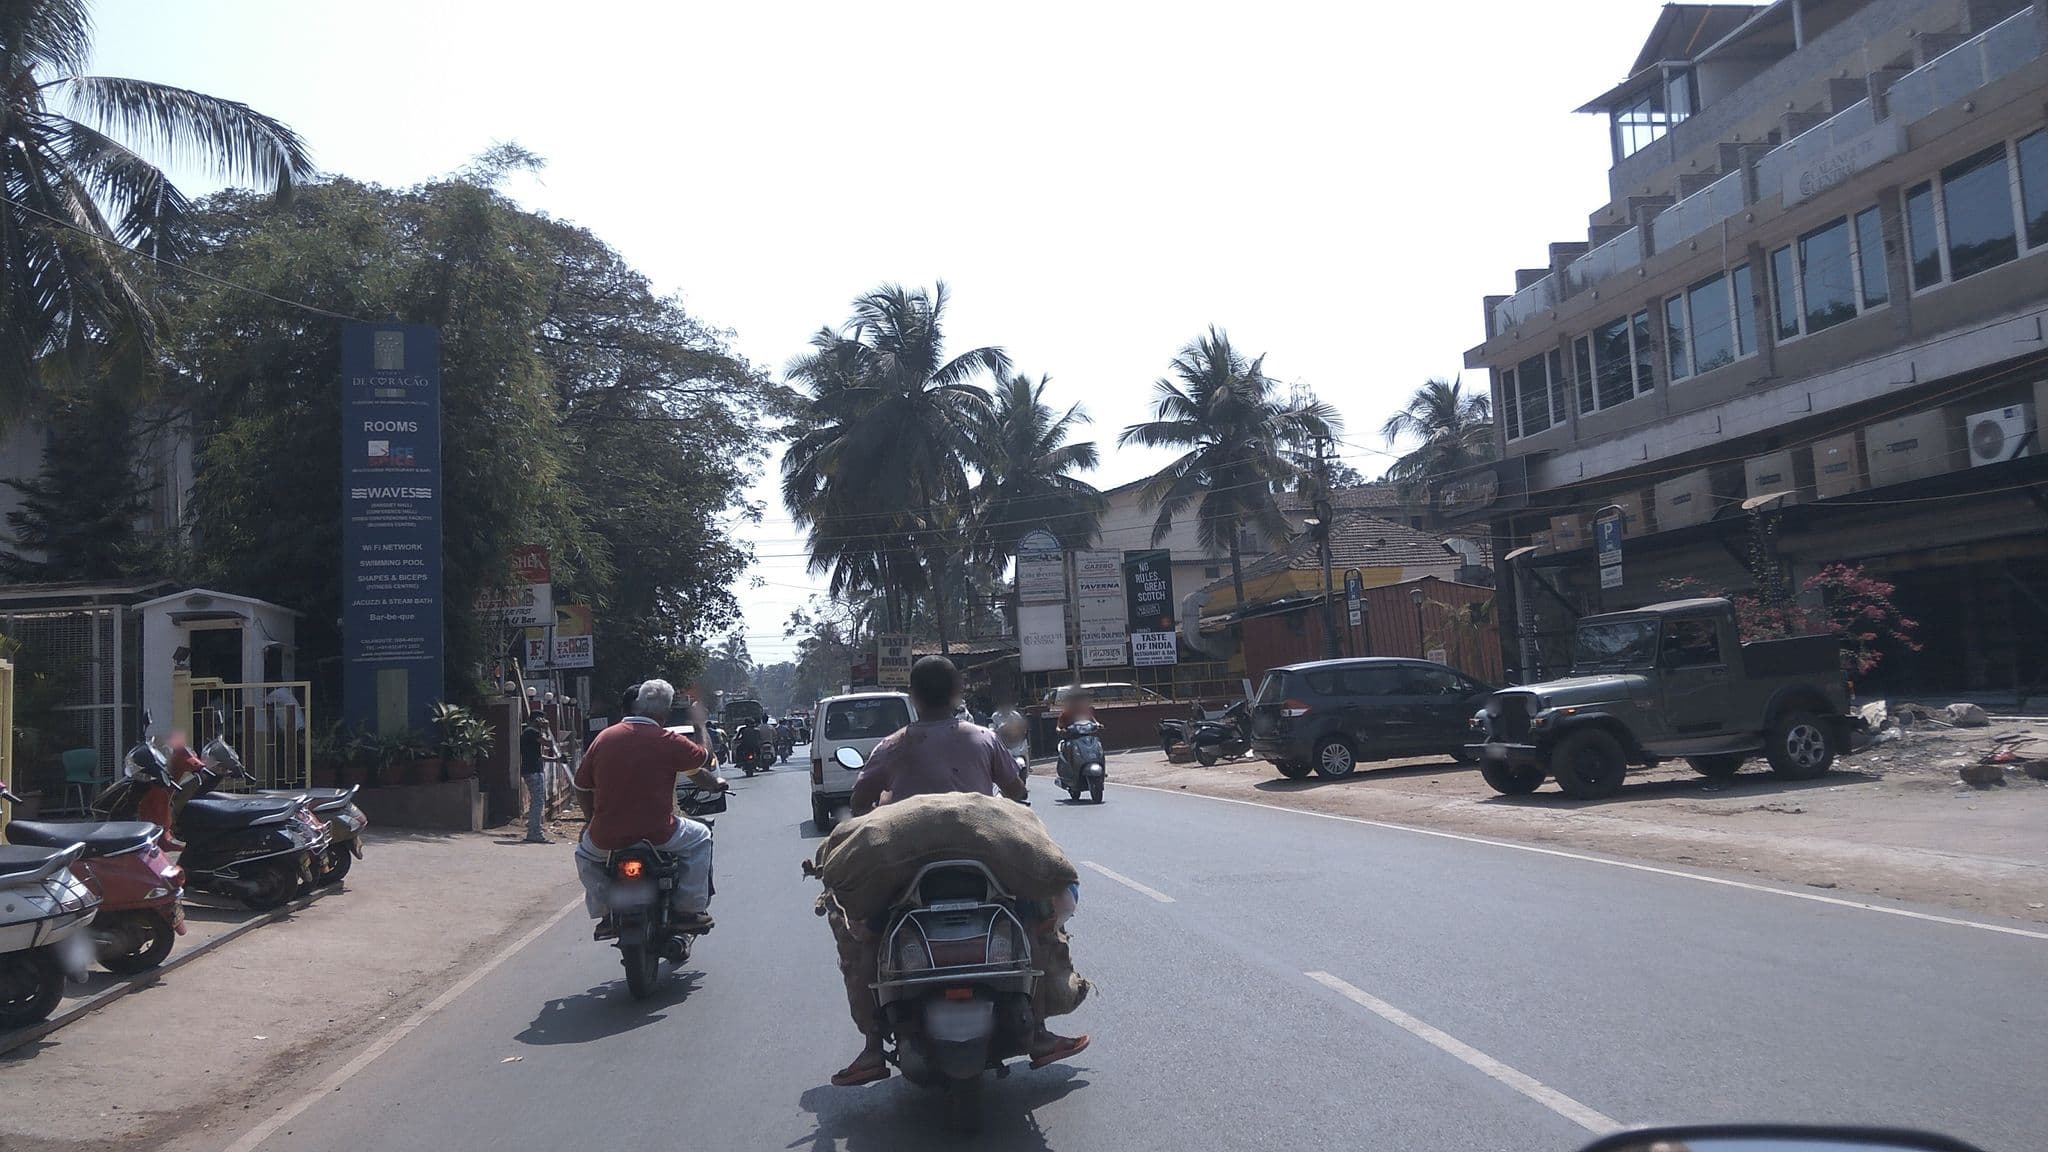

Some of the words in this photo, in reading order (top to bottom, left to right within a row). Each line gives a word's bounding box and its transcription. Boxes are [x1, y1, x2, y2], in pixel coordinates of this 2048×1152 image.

[363, 421, 418, 432] ROOMS
[367, 487, 416, 498] WAVES
[1604, 523, 1613, 540] P
[1139, 562, 1149, 572] NO
[1144, 581, 1166, 592] GREAT
[1350, 580, 1356, 592] P
[1137, 591, 1165, 602] SCOTCH
[369, 613, 415, 623] Bar-be-que
[1141, 633, 1167, 642] TASTE
[1136, 642, 1147, 650] OF
[1149, 641, 1172, 650] INDIA
[881, 657, 908, 666] INDIA
